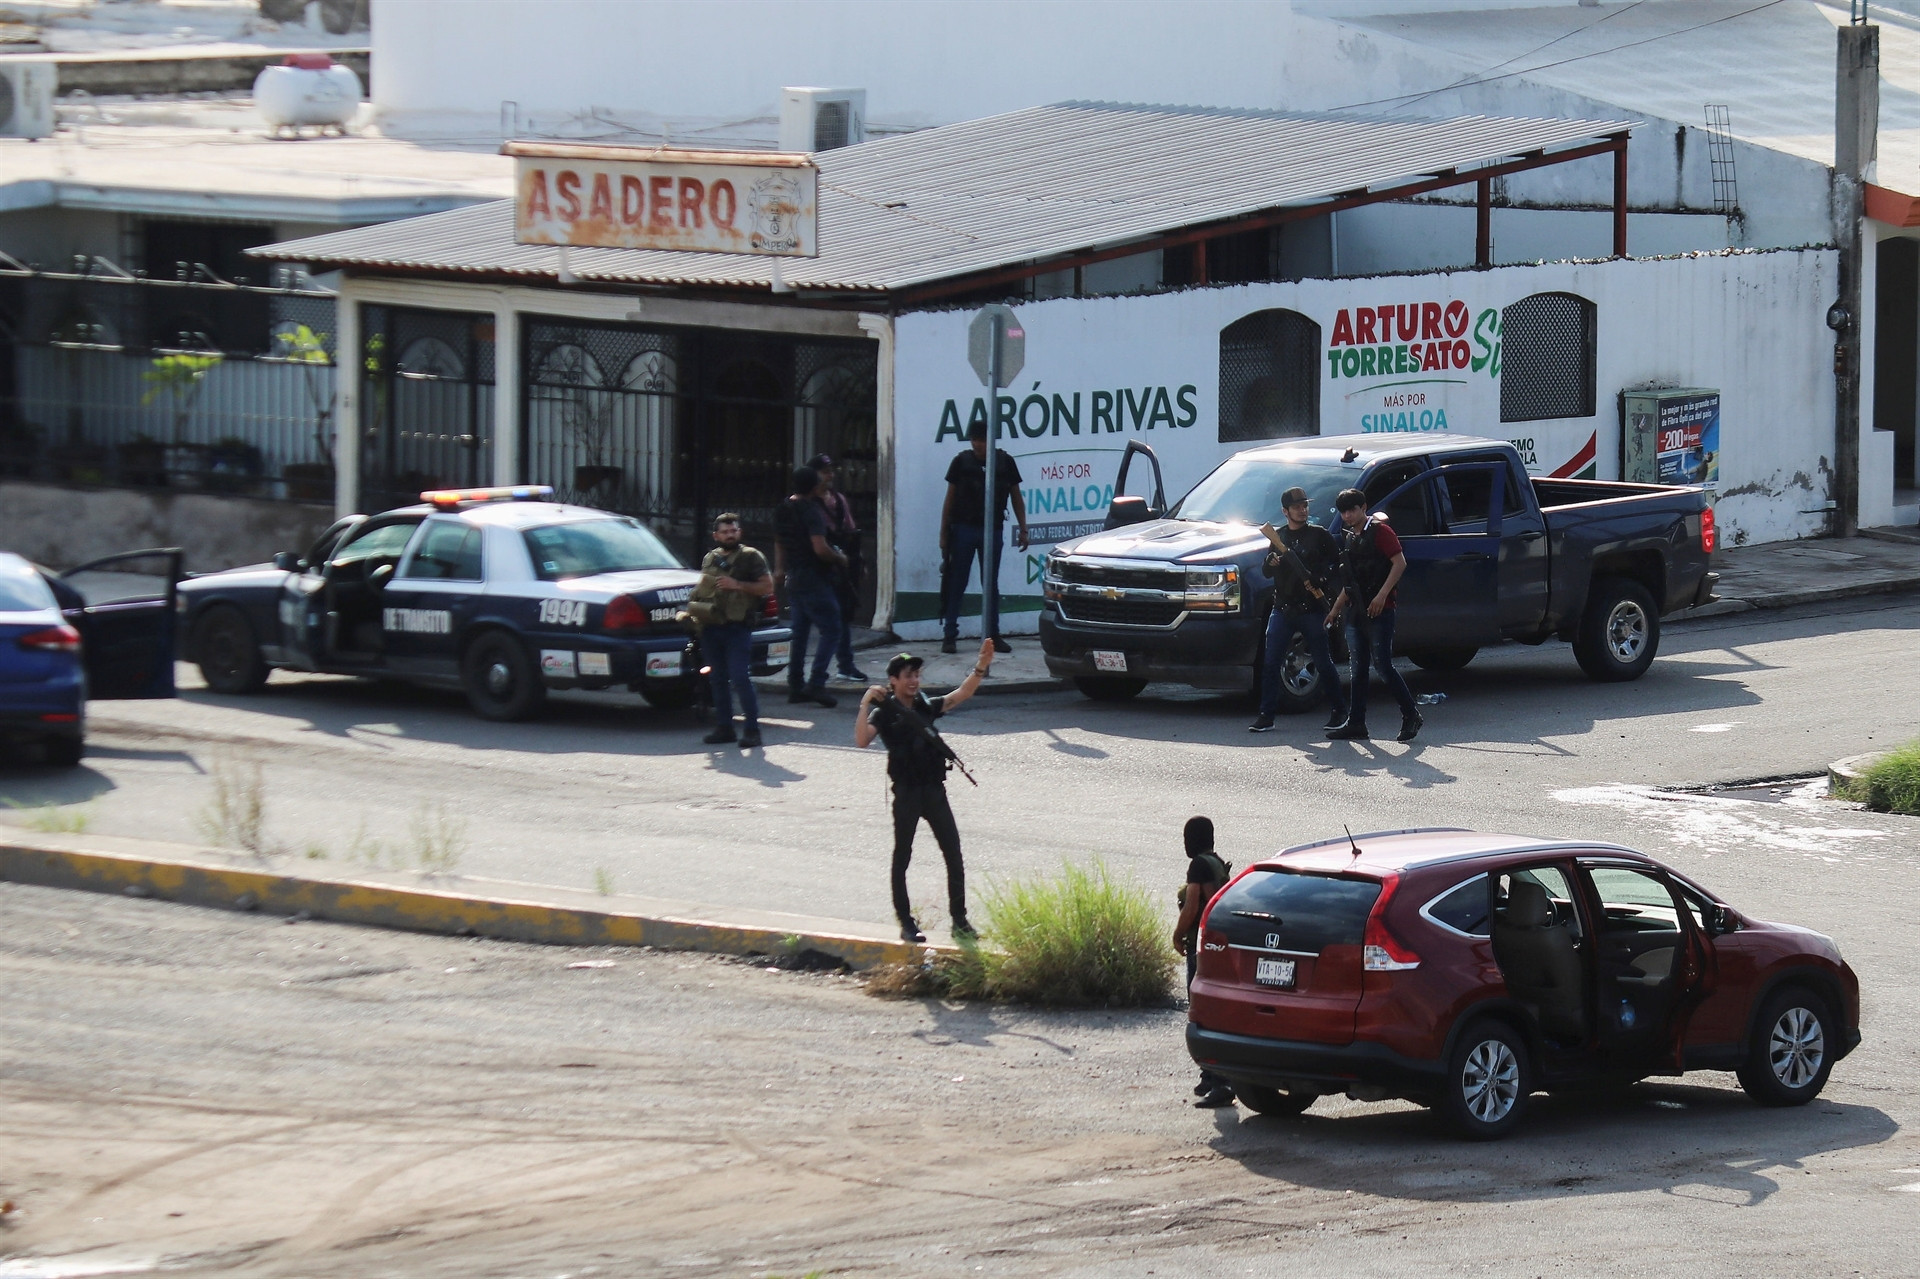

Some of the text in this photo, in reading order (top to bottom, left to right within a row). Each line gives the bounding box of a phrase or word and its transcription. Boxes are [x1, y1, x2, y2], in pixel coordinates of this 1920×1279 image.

[526, 169, 737, 230] ASADERO
[1330, 299, 1469, 347] ARTURO
[1327, 339, 1471, 379] TORRESATO
[1383, 392, 1426, 408] MÁS POR
[1662, 408, 1666, 416] La
[1668, 405, 1679, 415] mejor
[1695, 399, 1709, 411] grande
[935, 381, 1198, 442] AARÓN RIVAS
[1361, 408, 1448, 433] SINALOA
[1662, 419, 1666, 427] de
[1667, 416, 1679, 426] Fibra
[1665, 429, 1683, 450] 200
[1041, 462, 1092, 480] MÁS POR
[1048, 524, 1073, 539] FEDERAL
[539, 599, 588, 627] 1994
[650, 607, 677, 622] 1994
